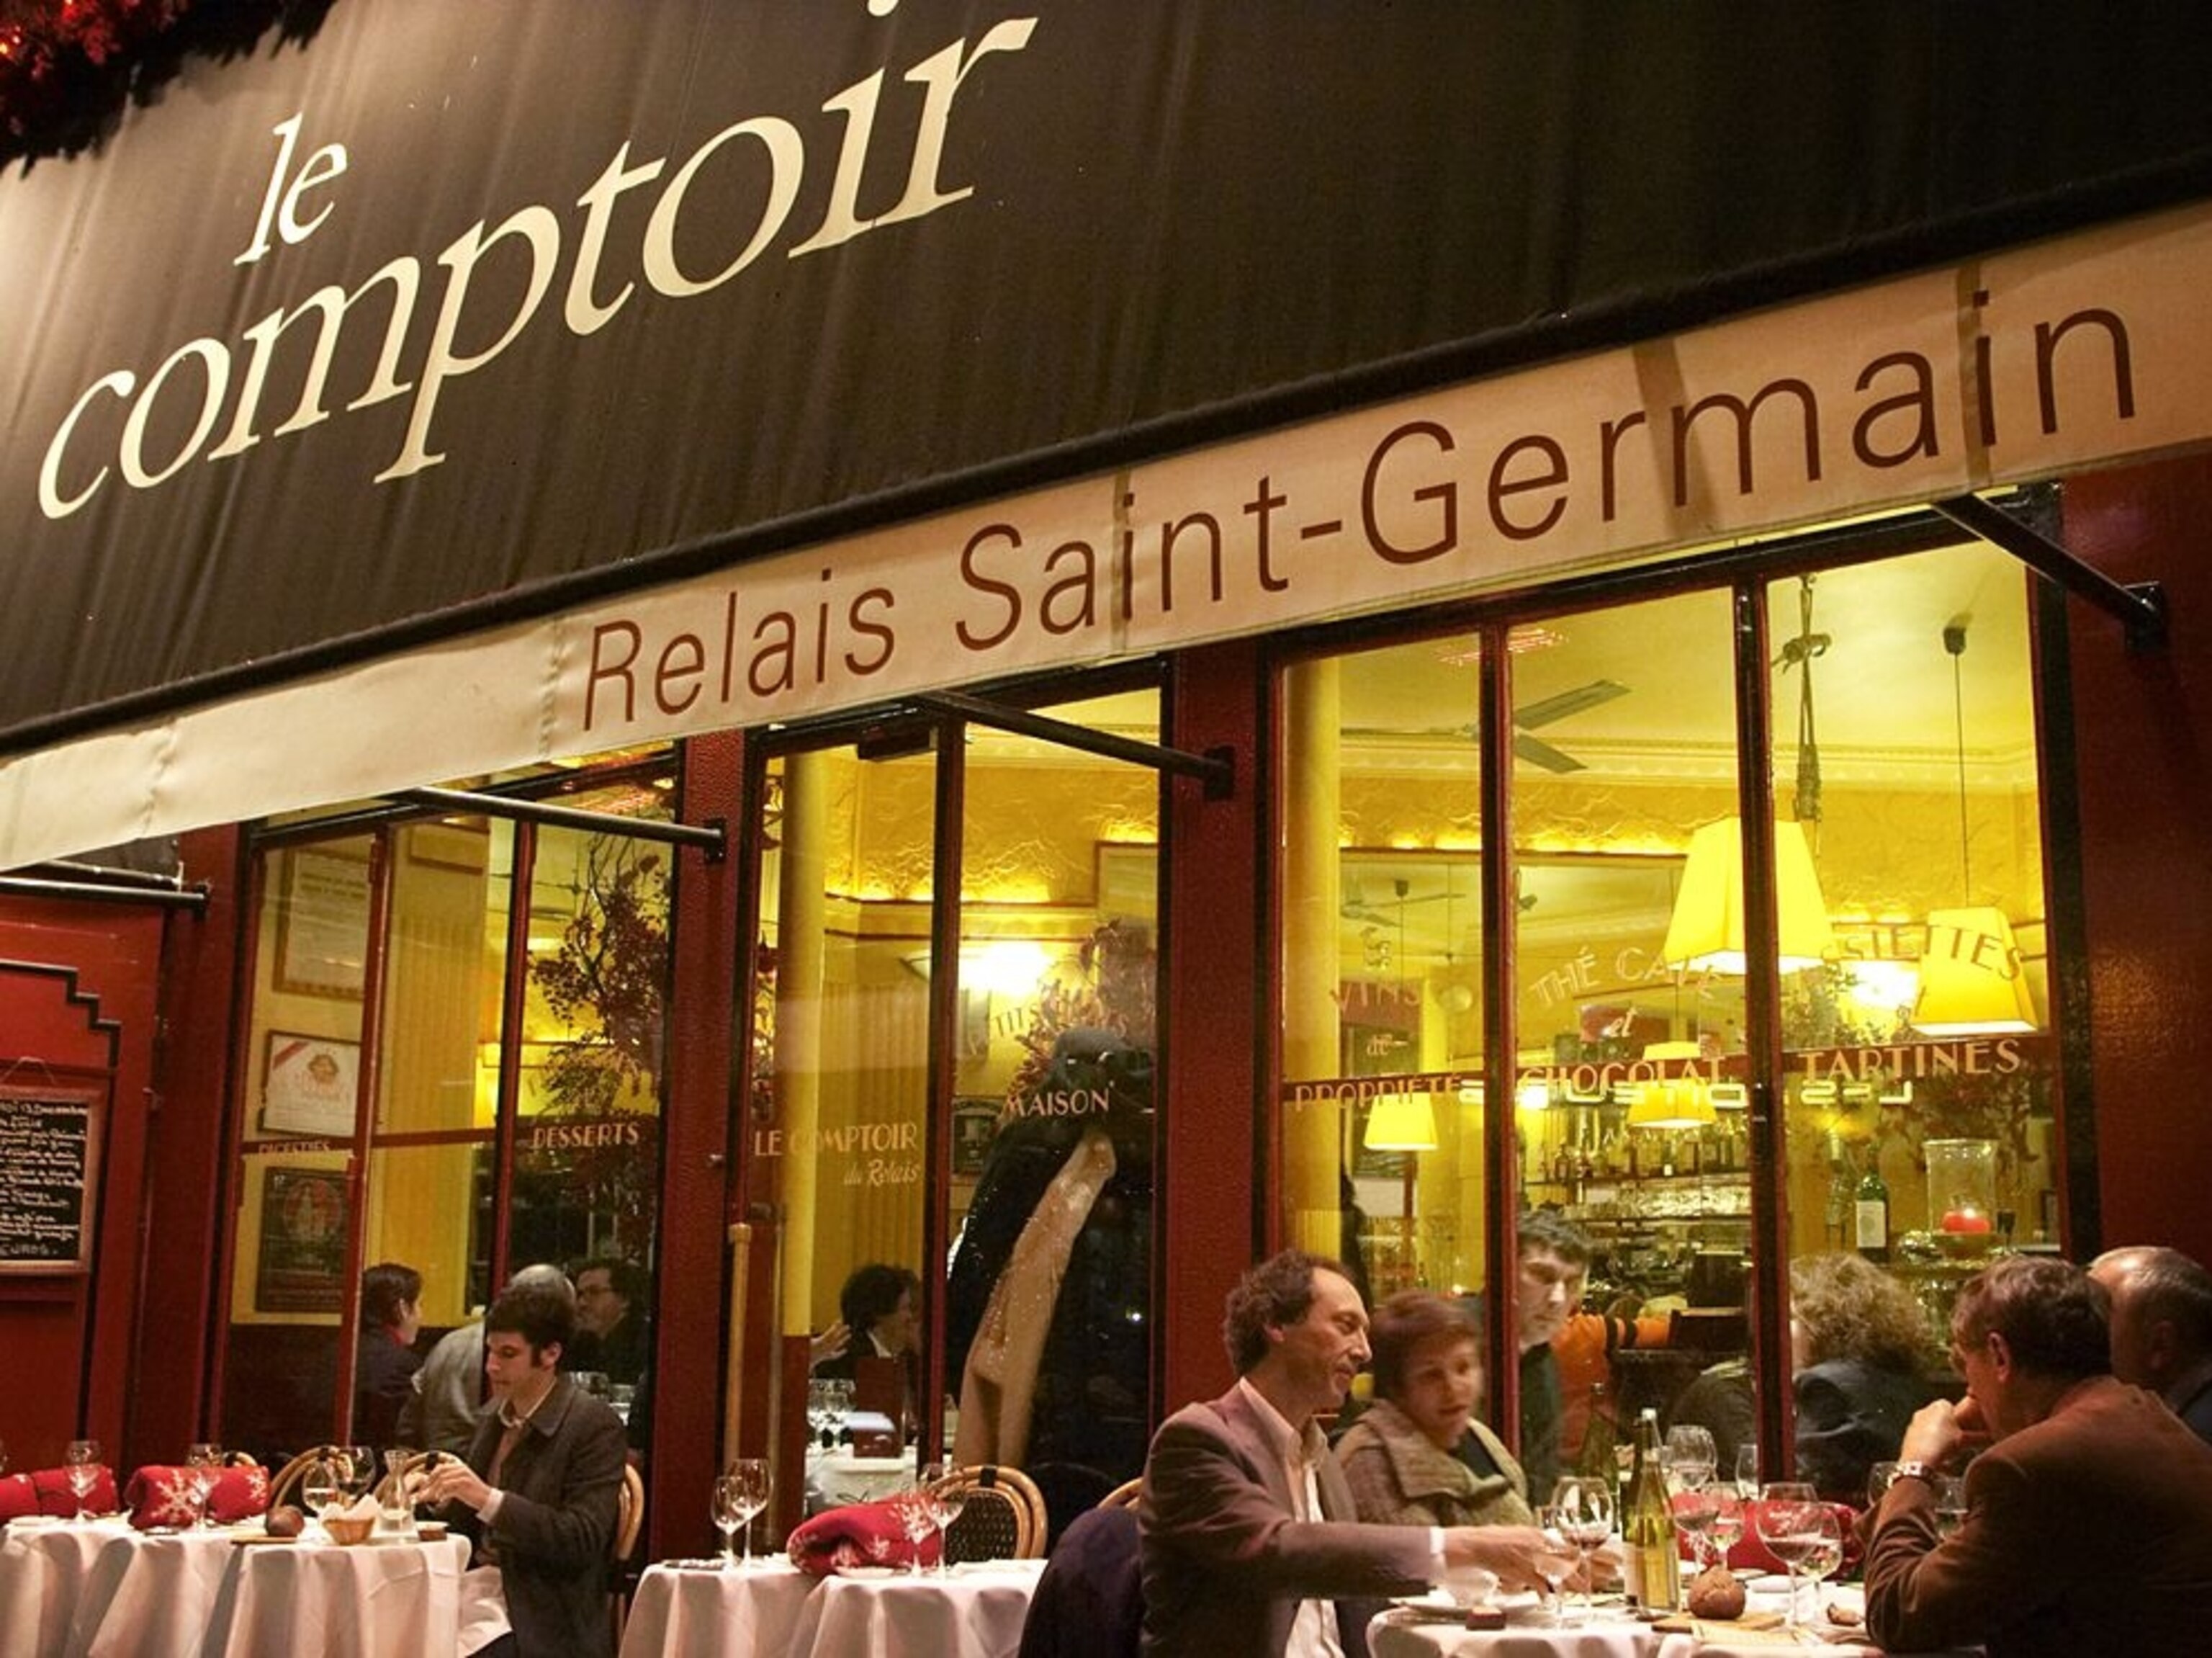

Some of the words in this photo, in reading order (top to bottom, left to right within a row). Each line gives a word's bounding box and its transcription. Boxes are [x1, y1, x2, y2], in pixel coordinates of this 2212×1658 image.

[234, 112, 348, 266] le
[39, 0, 1038, 519] comptoir
[584, 568, 895, 731] Relais
[956, 290, 2136, 651] Saint-Germain
[1529, 946, 1601, 1007] THÉ
[1601, 1004, 1639, 1038] et
[1519, 1054, 1726, 1096] CHOCOLAT
[1797, 1039, 2021, 1082] TARTINES
[1004, 1087, 1110, 1117] MAISON
[531, 1121, 640, 1149] DESSERTS
[755, 1129, 783, 1157] LE
[867, 1158, 922, 1187] Relais
